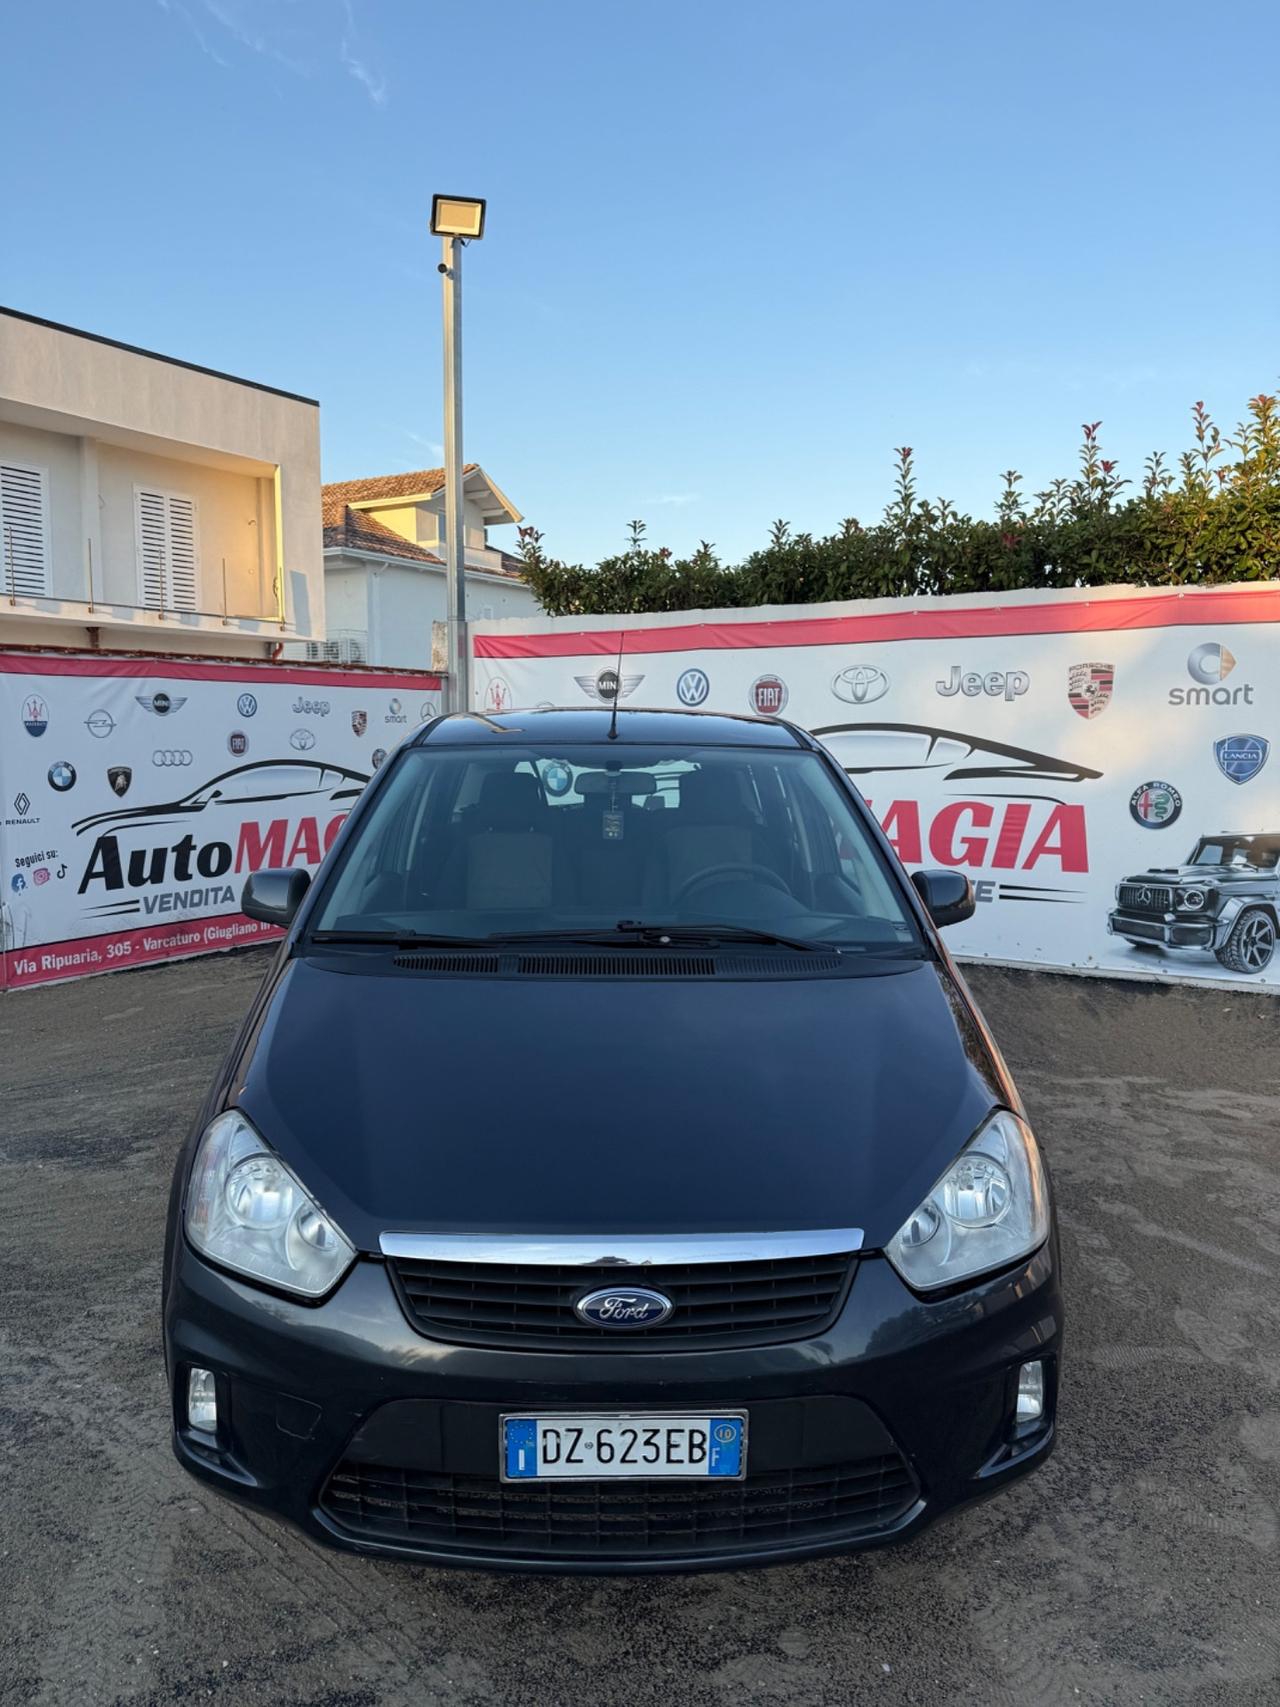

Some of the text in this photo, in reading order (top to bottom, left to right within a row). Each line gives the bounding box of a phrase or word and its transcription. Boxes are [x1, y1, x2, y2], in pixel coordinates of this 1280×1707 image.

[935, 666, 1030, 702] Jeep
[1168, 684, 1254, 706] smart
[292, 697, 331, 717] Jeep
[758, 688, 780, 707] FIAT
[384, 715, 407, 724] smart
[1223, 752, 1258, 760] LANCIA
[1131, 782, 1182, 807] ALFA ROMEO
[5, 817, 41, 826] RENAULT
[864, 799, 1089, 873] AGIA
[15, 851, 45, 868] Seguici
[143, 885, 235, 914] VENDITA
[14, 959, 37, 975] Via
[41, 949, 102, 970] Ripuaria,
[106, 941, 132, 958] 305
[143, 932, 200, 951] Varcaturo
[203, 921, 258, 945] (Giugliano
[599, 1297, 649, 1320] Ford
